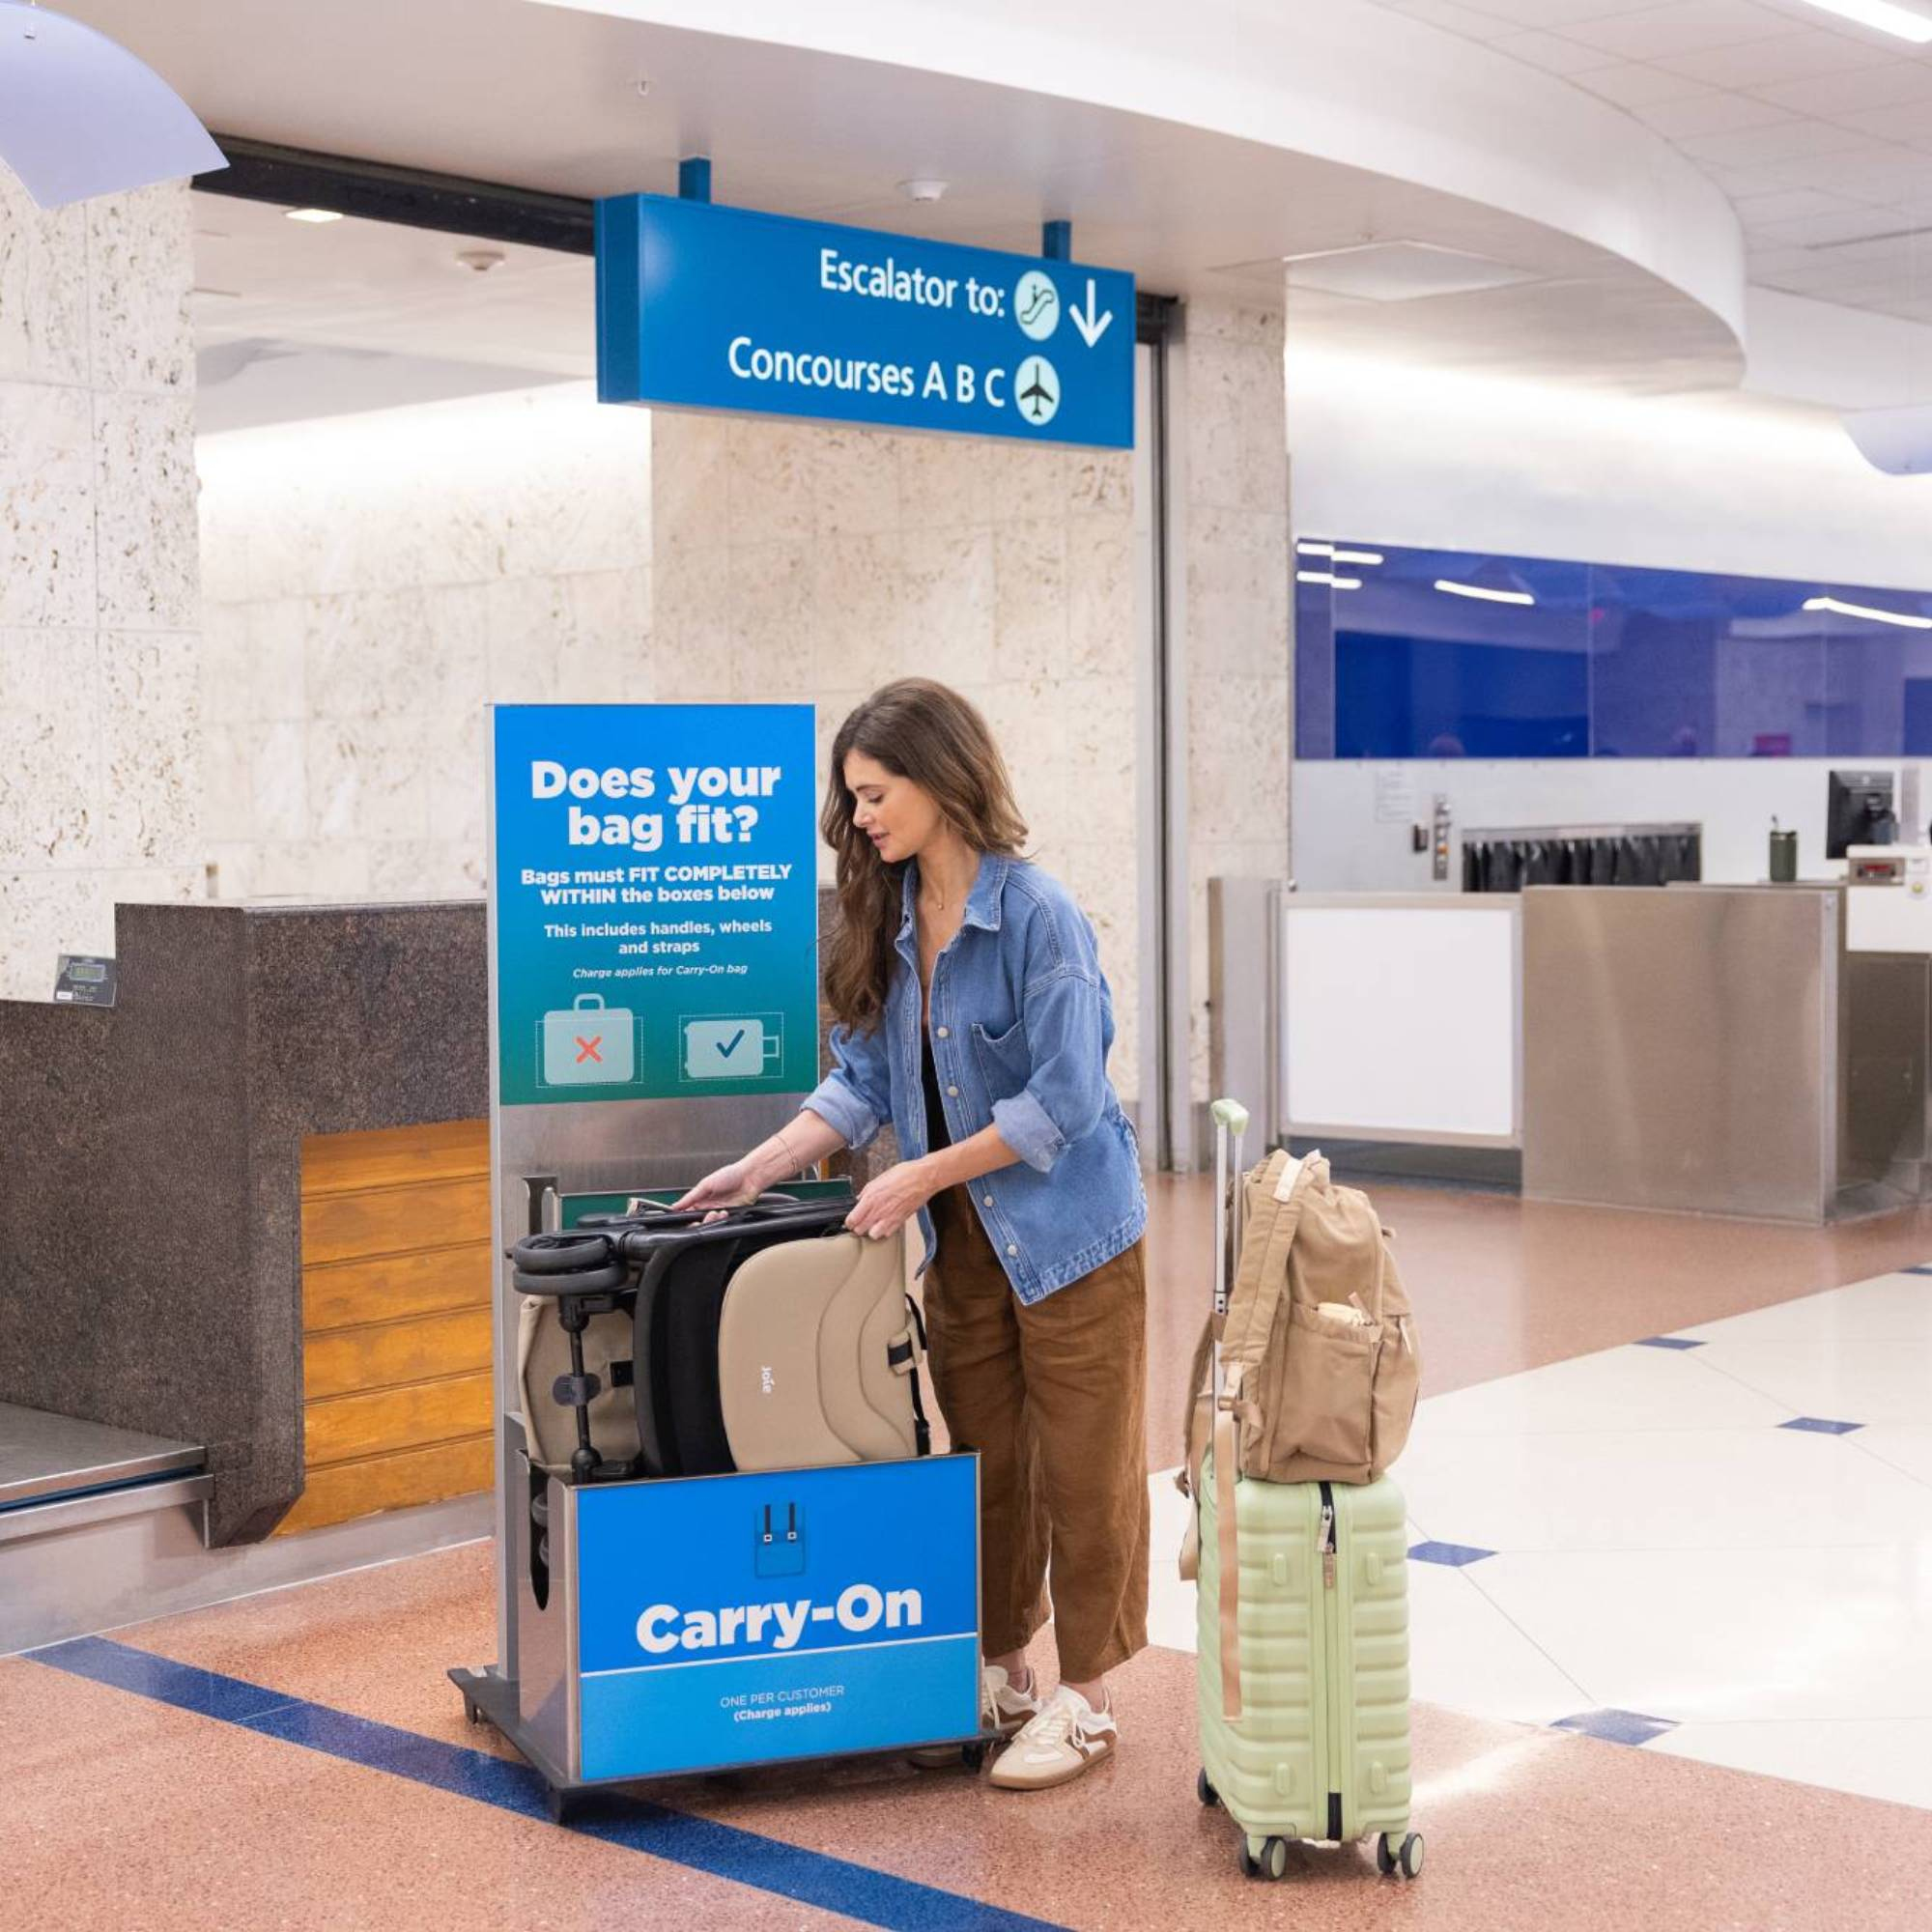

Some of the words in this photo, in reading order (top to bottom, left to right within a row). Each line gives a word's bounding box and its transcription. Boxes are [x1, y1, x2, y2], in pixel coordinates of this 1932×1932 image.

[820, 248, 956, 309] Escalator
[966, 276, 1006, 318] to:
[728, 336, 915, 398] Concourses
[922, 361, 948, 401] A
[956, 366, 976, 404] B
[984, 368, 1006, 408] C
[531, 760, 655, 799] Does
[668, 764, 781, 805] your
[568, 807, 664, 851] bag
[676, 805, 758, 843] fit?
[522, 868, 570, 886] Bags
[574, 868, 625, 884] must
[629, 867, 659, 882] FIT
[664, 865, 792, 882] COMPLETELY
[541, 889, 616, 905] WITHIN
[621, 888, 653, 903] the
[657, 887, 713, 901] boxes
[718, 885, 774, 900] below
[545, 924, 577, 937] This
[582, 923, 646, 936] includes
[650, 922, 715, 937] handles,
[719, 920, 772, 932] wheels
[618, 941, 648, 953] and
[652, 941, 699, 955] straps
[573, 969, 611, 980] Charge
[615, 967, 654, 979] applies
[657, 966, 673, 976] for
[675, 965, 724, 977] Carry-On
[727, 964, 748, 976] bag
[636, 1583, 922, 1654] Carry-On
[721, 1695, 748, 1708] ONE
[751, 1692, 775, 1705] PER
[777, 1686, 844, 1703] CUSTOMER
[733, 1707, 781, 1721] (Charge
[784, 1701, 831, 1718] applies)
